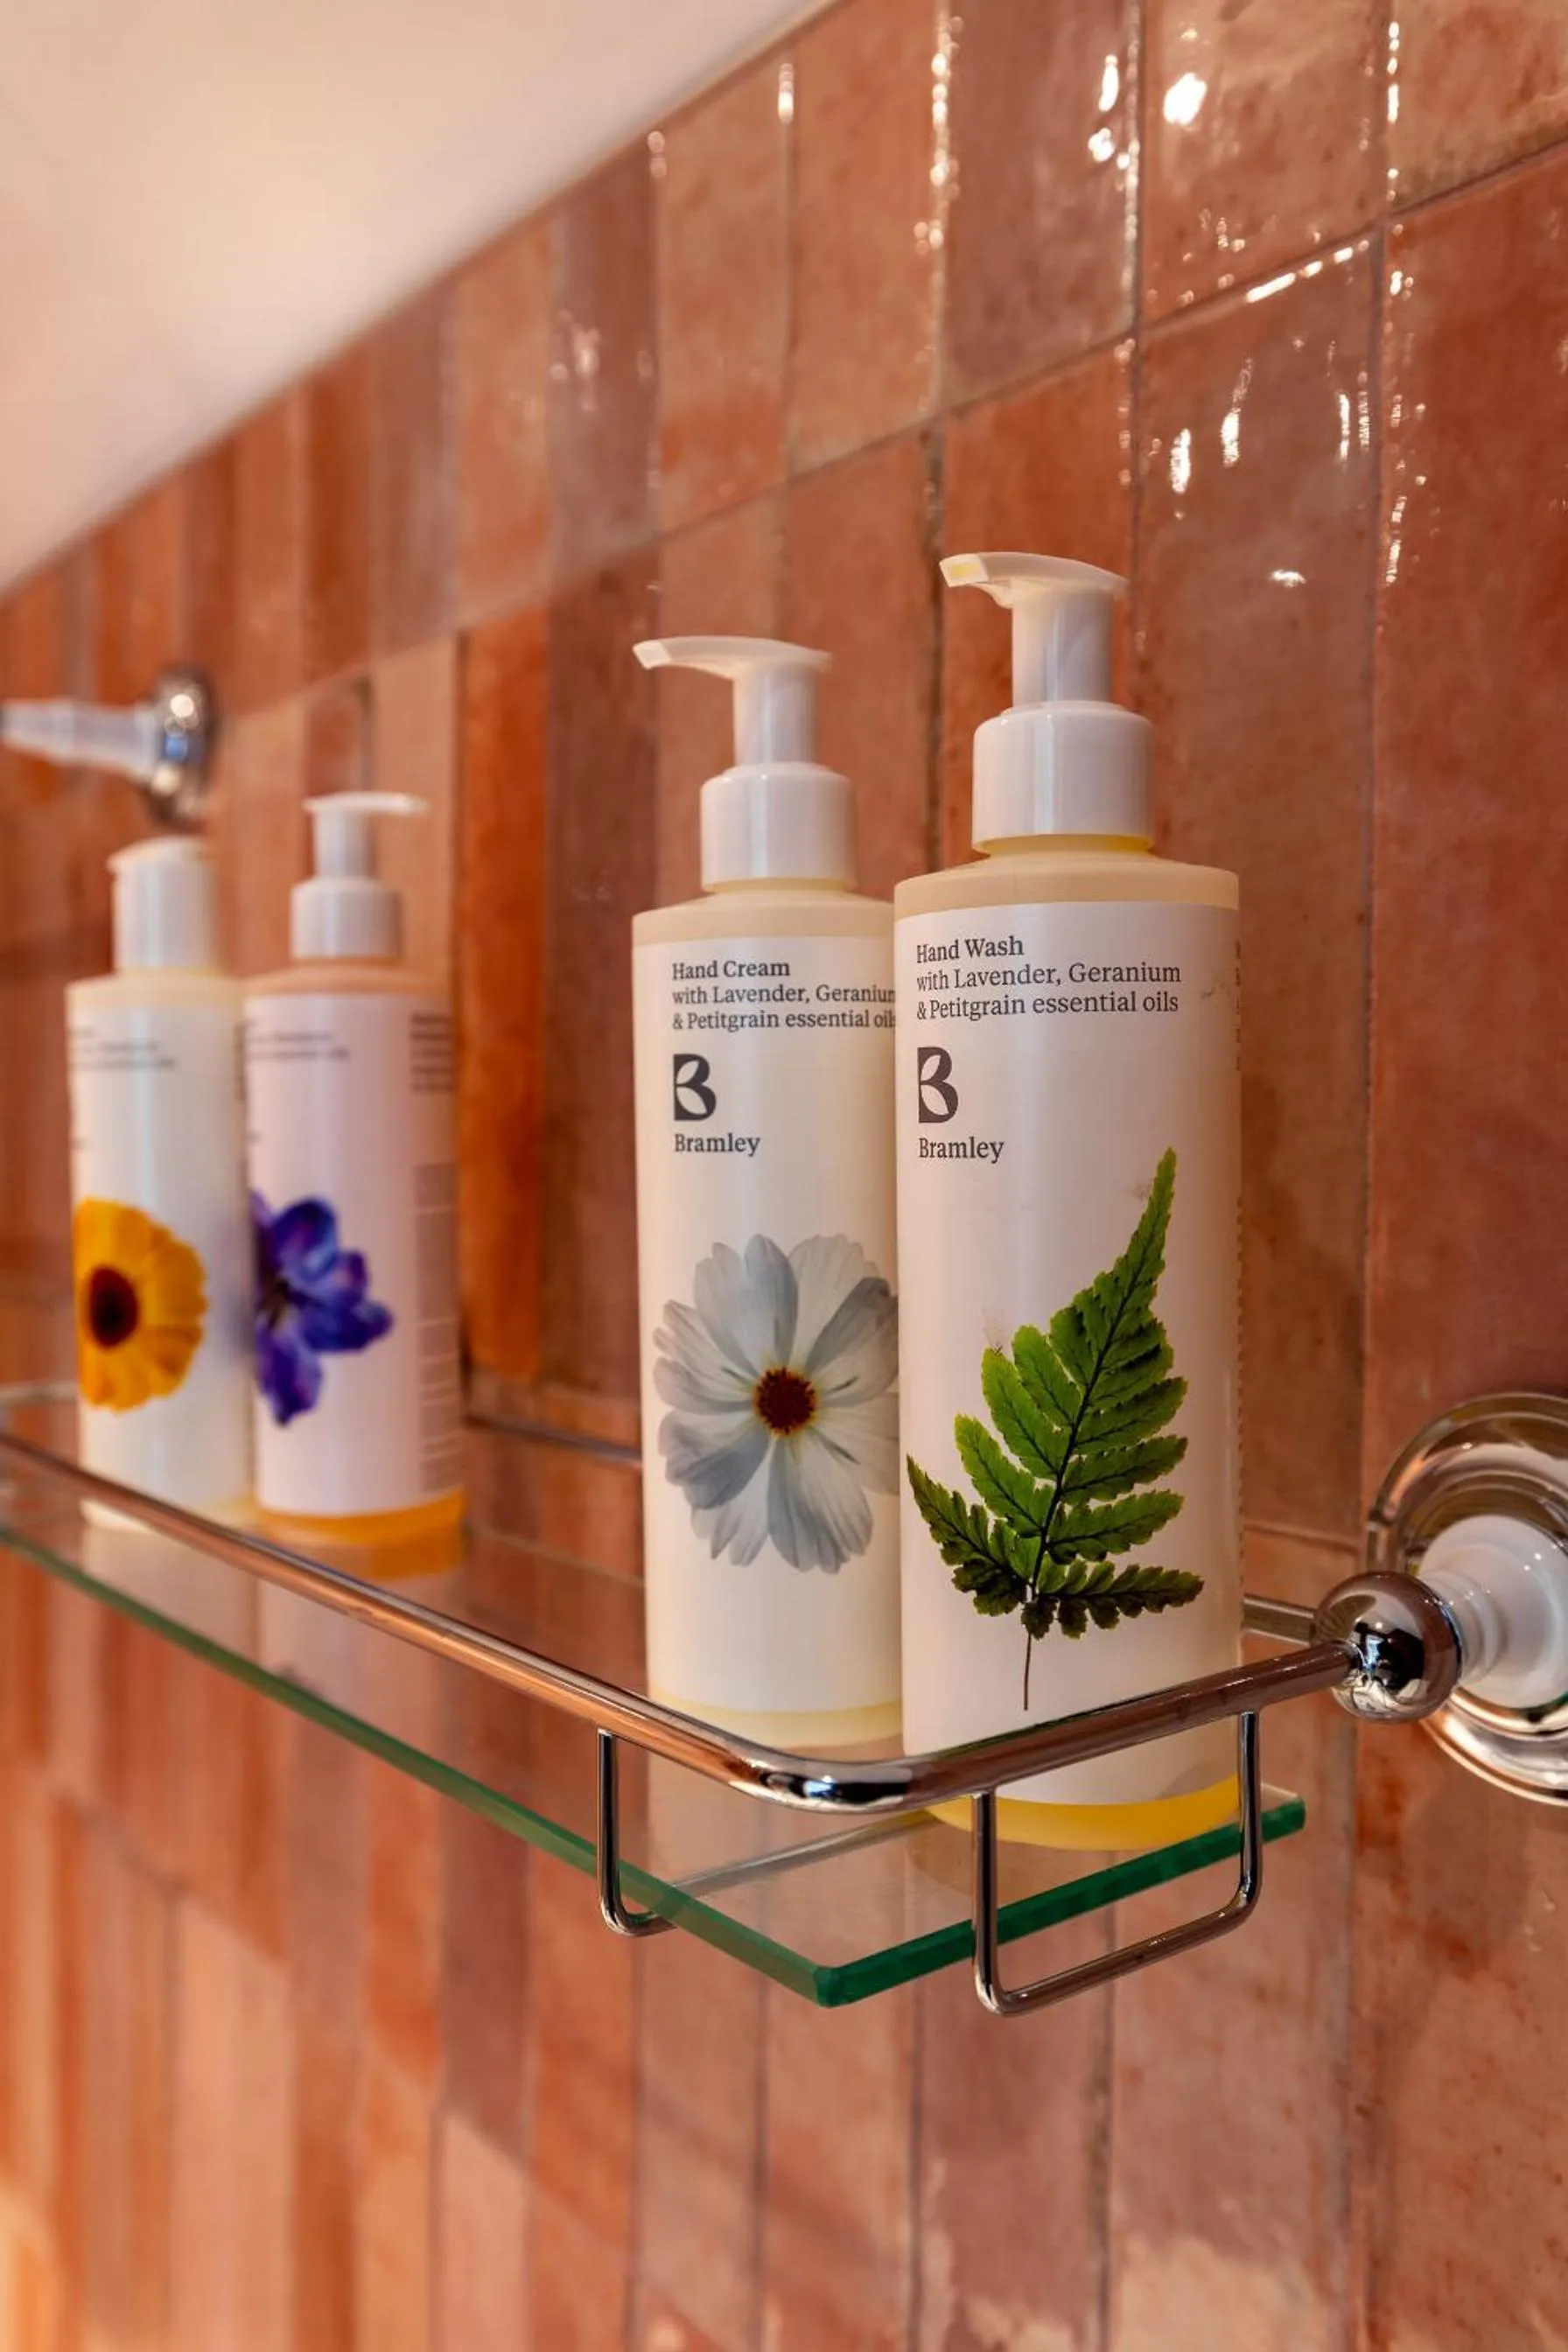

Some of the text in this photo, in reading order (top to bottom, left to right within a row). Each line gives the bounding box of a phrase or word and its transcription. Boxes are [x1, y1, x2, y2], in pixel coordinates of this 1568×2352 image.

[916, 936, 1024, 963] Hand Wash
[672, 961, 790, 980] Hand Cream
[916, 962, 1181, 991] with Lavender, Geranium
[672, 987, 708, 1004] with
[713, 985, 810, 1004] Lavender,
[916, 991, 1179, 1021] & Petitgrain essential oils
[672, 1013, 682, 1029] &
[687, 1011, 779, 1032] Petitgrain
[785, 1011, 869, 1027] essential
[675, 1132, 760, 1157] Bramley
[919, 1137, 1004, 1164] Bramley
